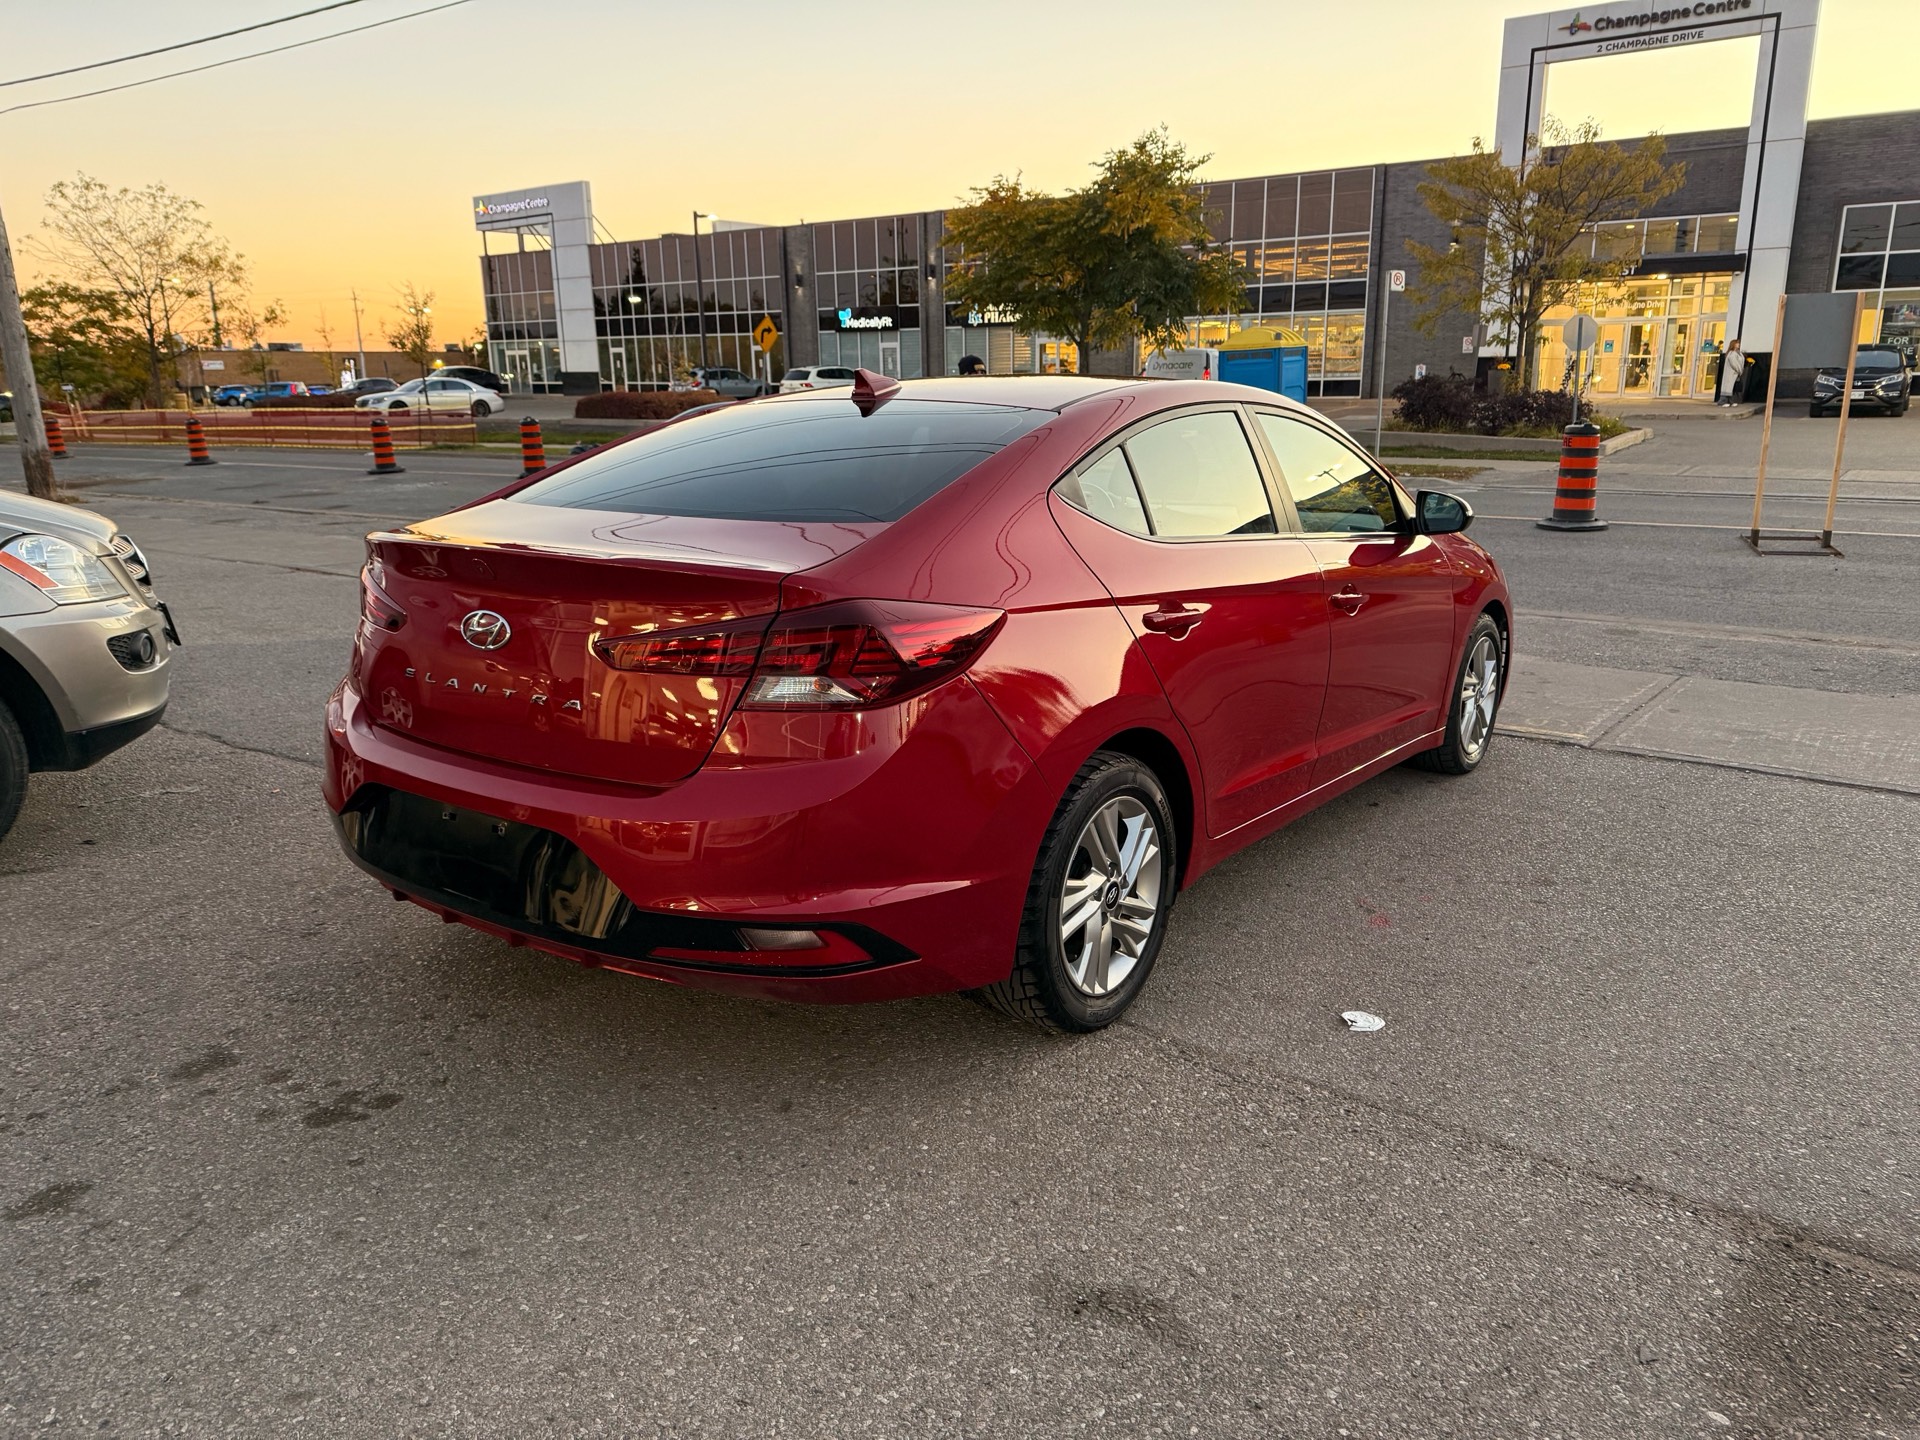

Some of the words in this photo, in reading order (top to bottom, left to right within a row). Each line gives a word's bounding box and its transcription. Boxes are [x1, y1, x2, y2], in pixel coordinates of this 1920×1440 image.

[1594, 7, 1691, 32] Champagne
[1693, 0, 1750, 17] Centre
[1605, 34, 1669, 51] CHAMPAGNE
[1672, 30, 1705, 43] DRIVE
[487, 201, 525, 214] Champagne
[525, 197, 549, 209] Centre
[846, 316, 893, 329] MedicallyFit
[1887, 337, 1909, 345] FOR
[1153, 361, 1194, 371] Dynacare
[404, 667, 582, 711] ELANTRA
